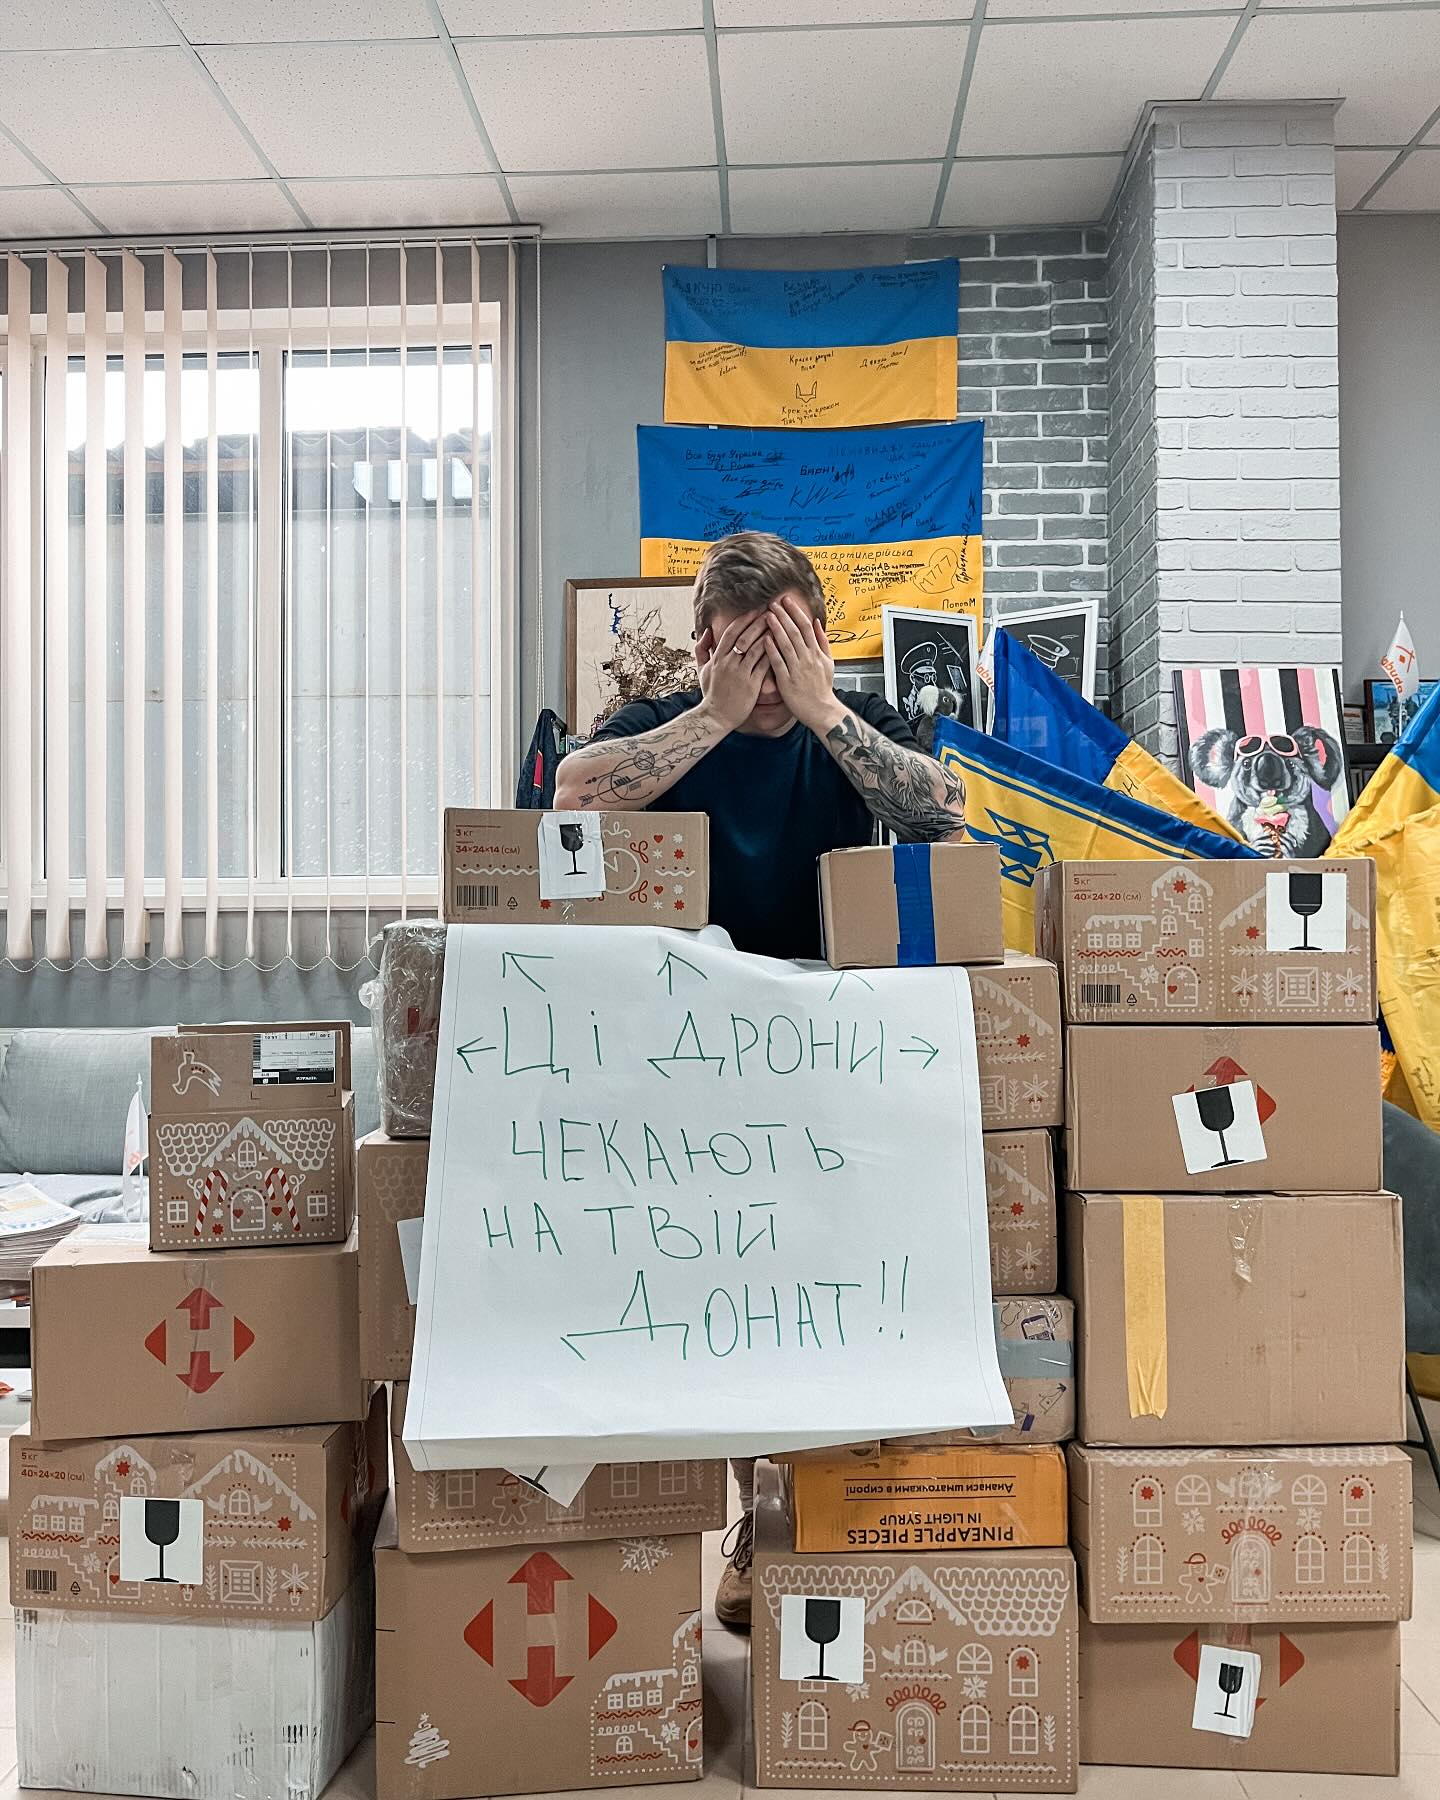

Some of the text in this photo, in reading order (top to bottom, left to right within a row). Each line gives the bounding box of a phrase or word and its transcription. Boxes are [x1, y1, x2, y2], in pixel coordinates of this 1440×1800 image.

[830, 548, 913, 562] артилерійська
[647, 1010, 885, 1085] ДРОНИ
[510, 1118, 847, 1187] ЧЕКАЮТЬ
[482, 1194, 779, 1260] НА ТВІЙ
[893, 1483, 963, 1495] шматочками
[965, 1482, 1014, 1495] Ананаси
[879, 1512, 982, 1525] IN LIGHT SYRUP
[847, 1525, 1014, 1545] PINEAPPLE PIECES
